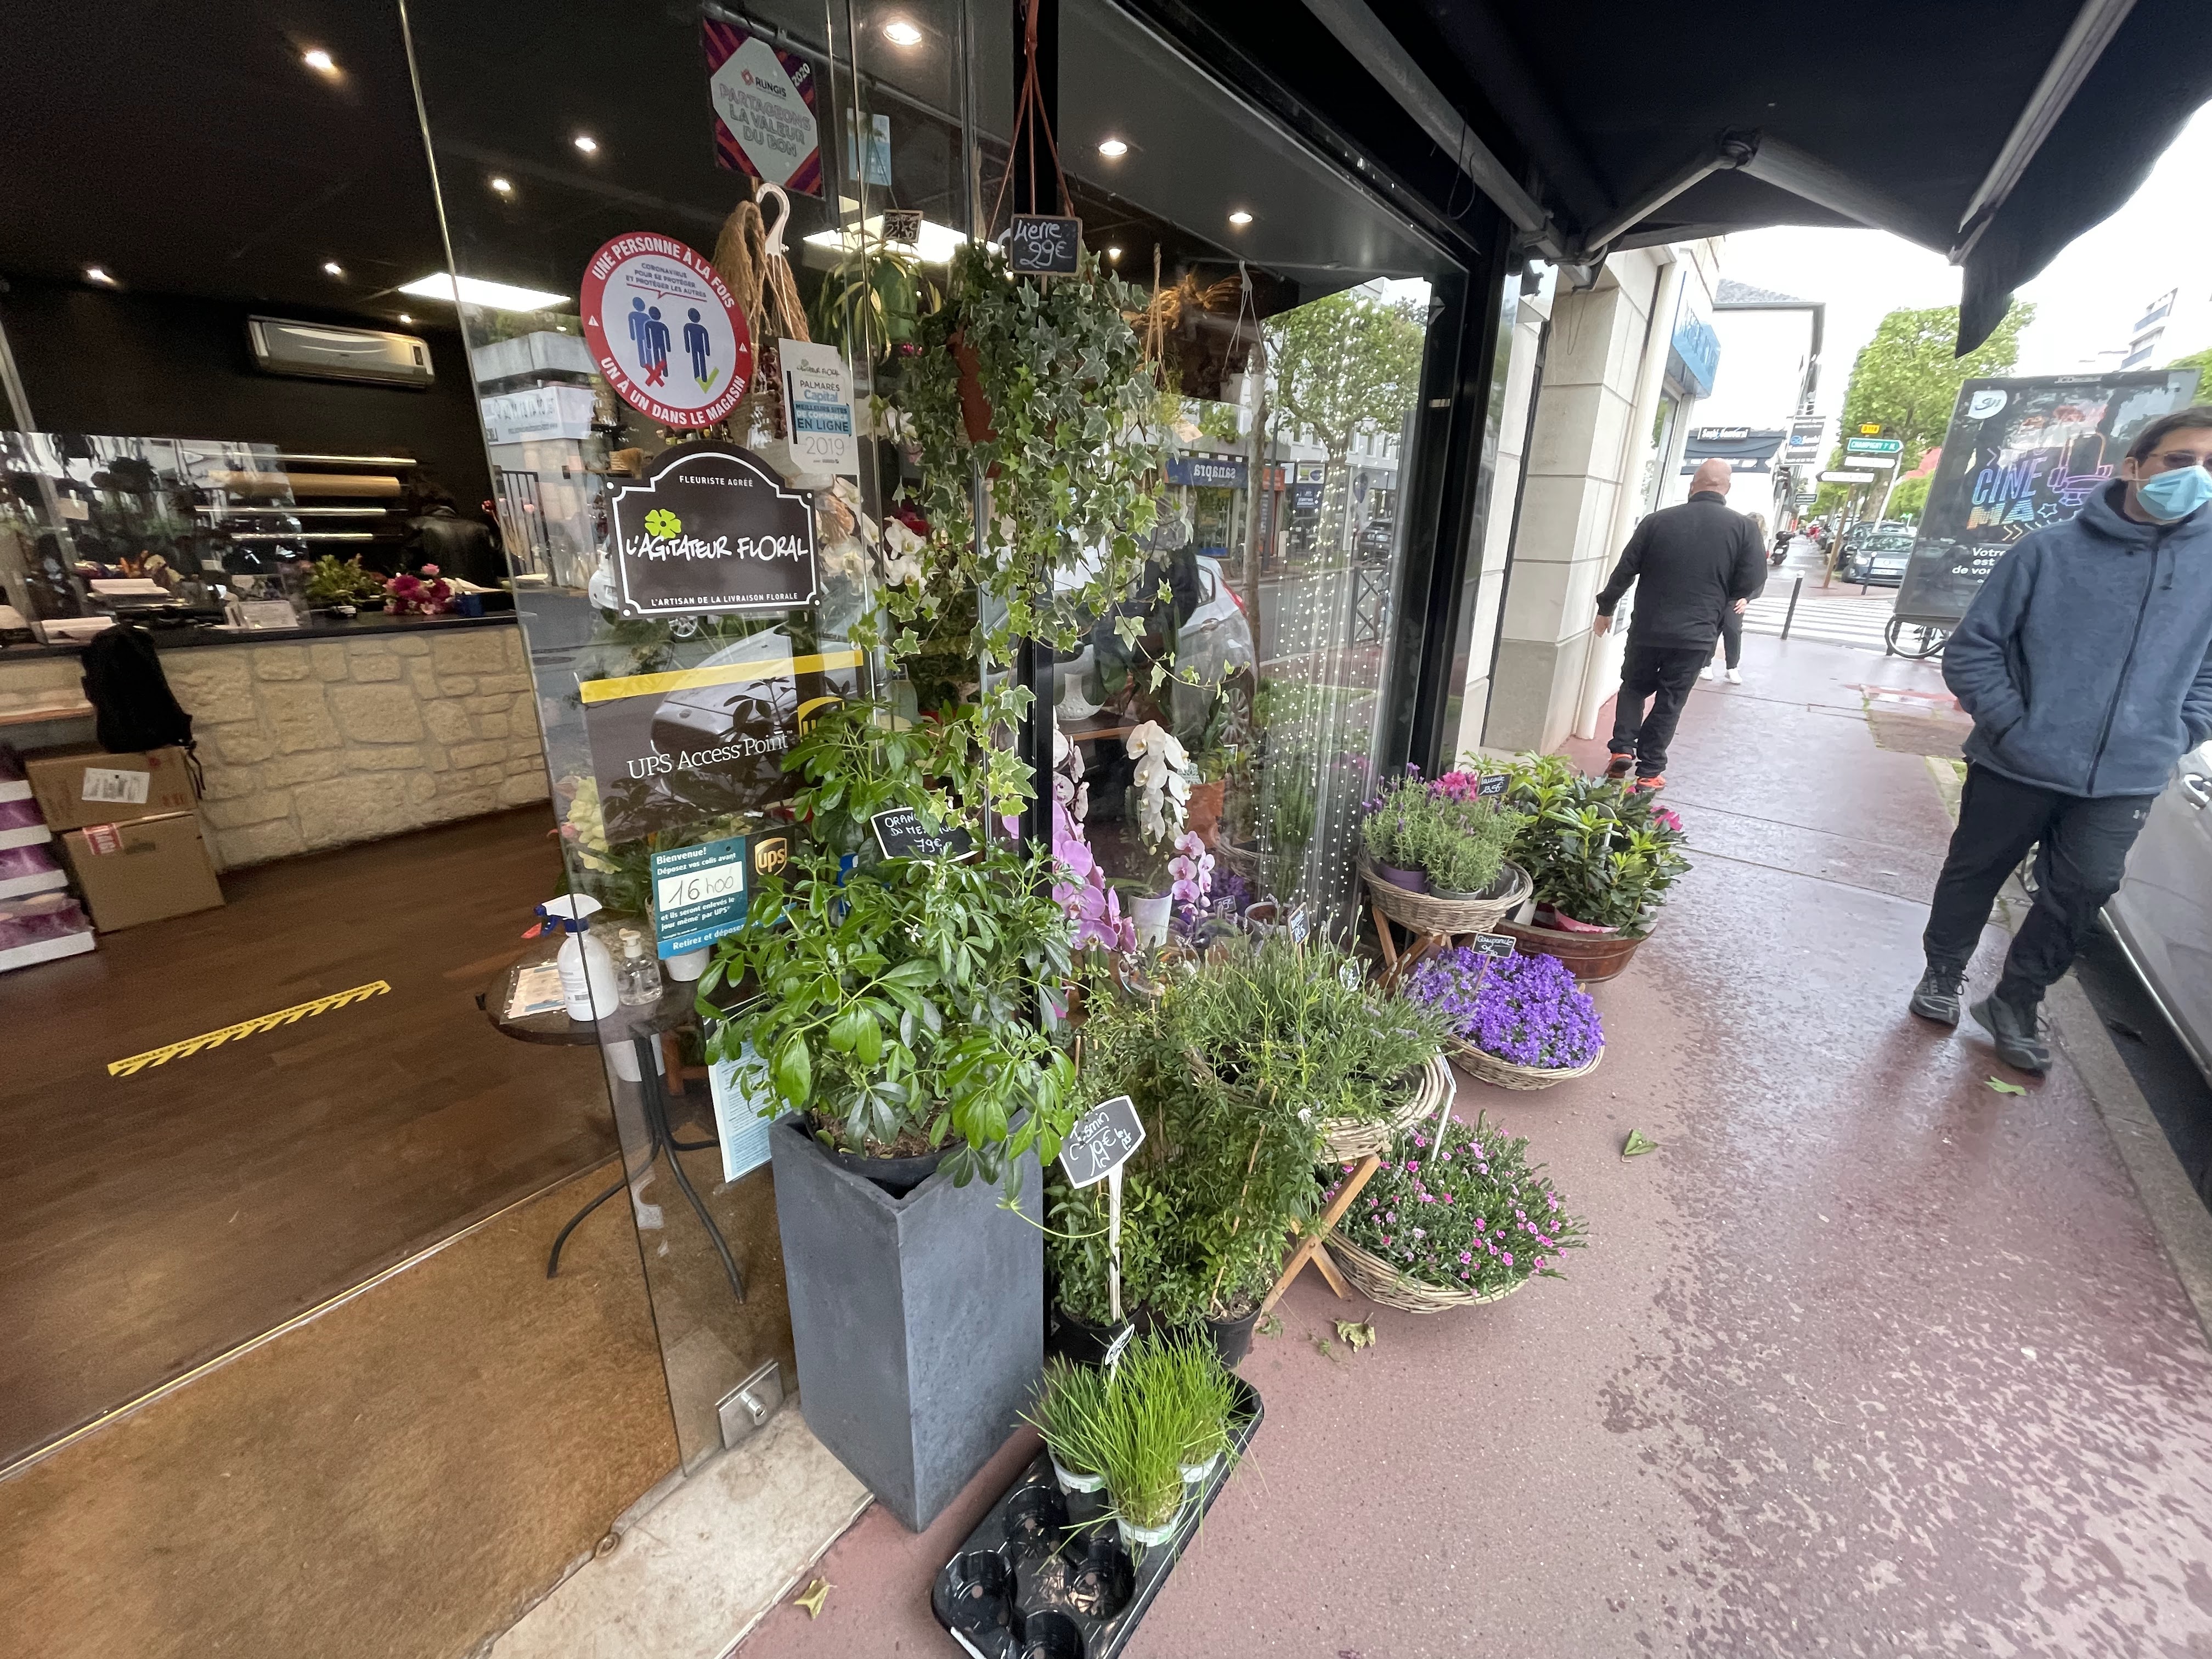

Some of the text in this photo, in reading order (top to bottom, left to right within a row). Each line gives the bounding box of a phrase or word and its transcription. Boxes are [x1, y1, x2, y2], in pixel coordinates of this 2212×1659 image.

[792, 63, 811, 87] 2020
[755, 77, 786, 97] RUNGIS
[719, 83, 811, 131] PARTAGEONS
[730, 104, 805, 145] LA VALEUR
[743, 125, 797, 157] DU BON
[1020, 239, 1073, 269] 29€
[592, 237, 735, 308] UNE PERSONNE À LA FOIS
[635, 269, 652, 278] POUR
[641, 263, 687, 278] CORONAVIRUS
[684, 288, 707, 297] AUTRES
[601, 357, 746, 425] UN À UN DANS LE MAGASIN
[800, 380, 840, 392] PALMARÈS
[804, 389, 838, 403] Capital
[795, 403, 830, 413] MEILLEURS
[808, 411, 848, 421] COMMERCE
[797, 418, 849, 432] EN LIGNE
[805, 436, 845, 456] 2019
[680, 475, 753, 487] FLEURISTE AGRÉÉ
[737, 534, 809, 562] FLORAL
[1952, 565, 1968, 574] de
[651, 597, 695, 607] L'ARTISAN
[697, 596, 708, 604] DE
[723, 594, 764, 603] LIVRAISON
[766, 592, 798, 601] FLORALE
[627, 733, 789, 779] UPS Access Point
[913, 838, 943, 853] 79€
[657, 847, 707, 865] Bienvenue!
[657, 864, 687, 876] Déposez
[702, 857, 716, 866] colis
[718, 853, 736, 862] avant
[758, 848, 785, 873] ups
[679, 906, 701, 917] seront
[702, 899, 727, 910] enlevés
[661, 922, 675, 932] jour
[702, 912, 713, 921] par
[673, 938, 702, 951] Retirez
